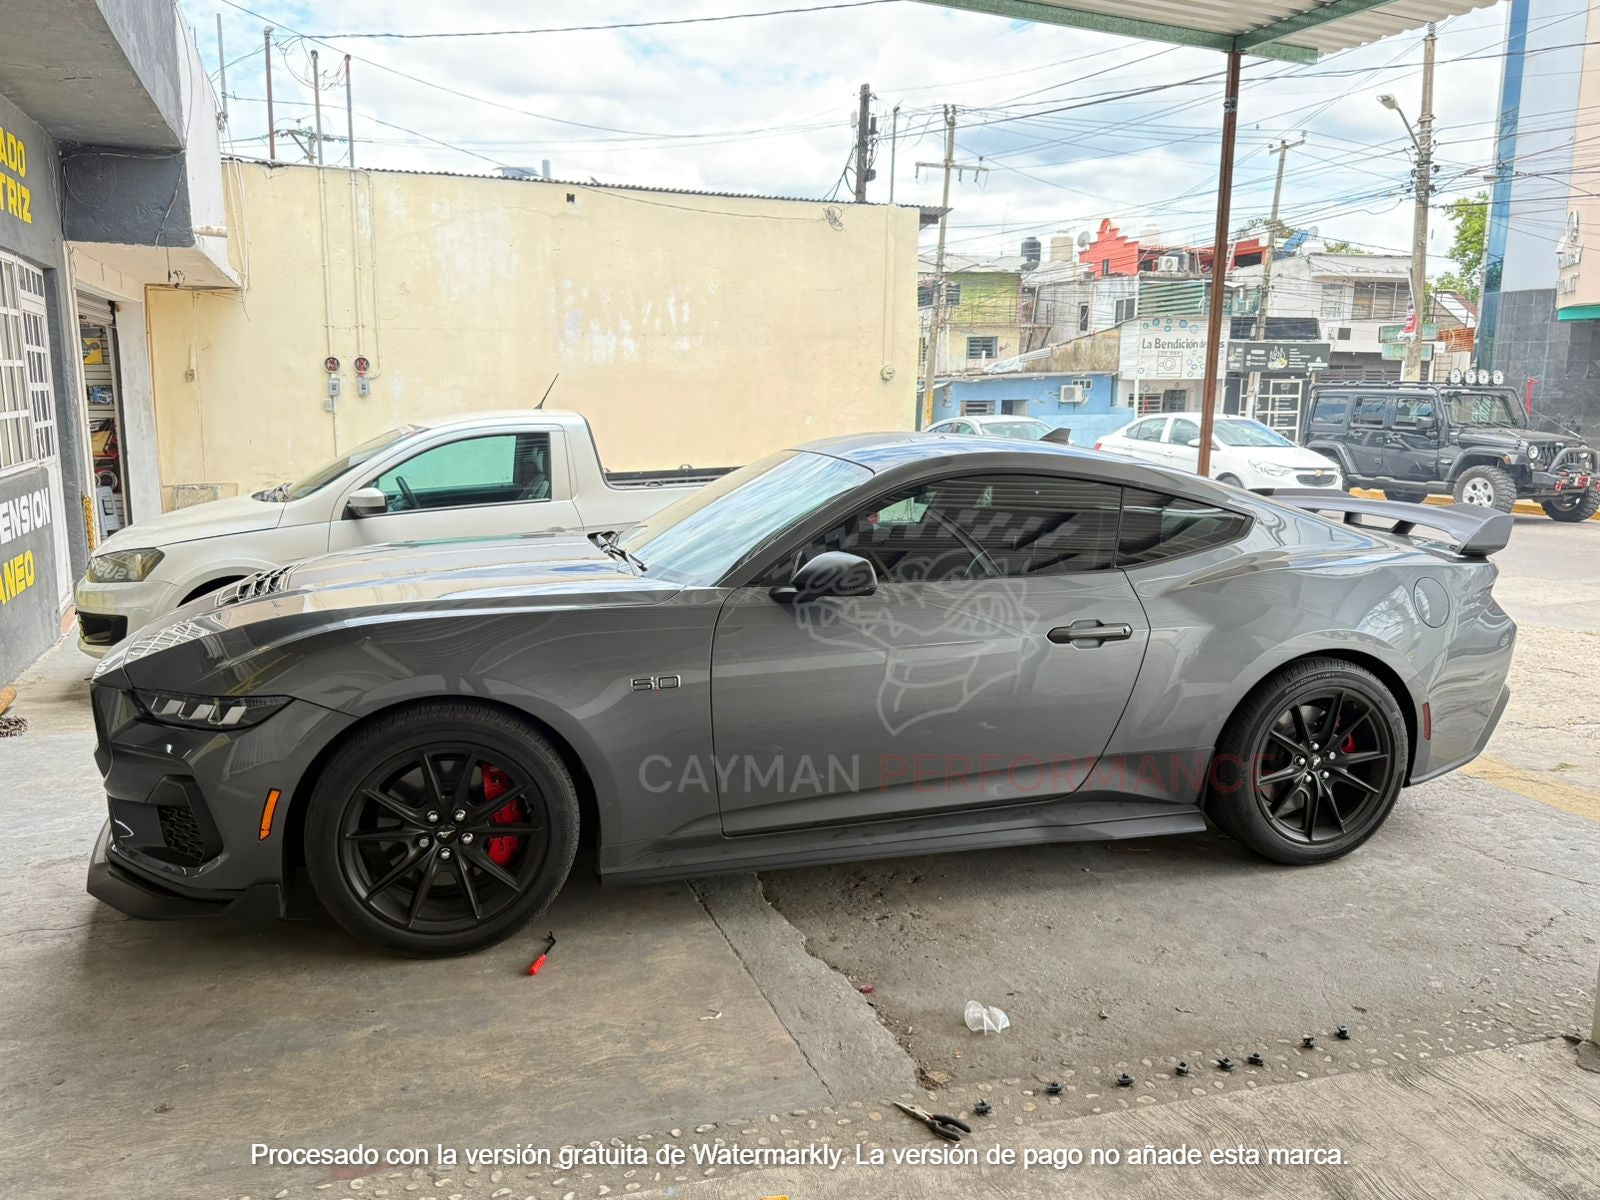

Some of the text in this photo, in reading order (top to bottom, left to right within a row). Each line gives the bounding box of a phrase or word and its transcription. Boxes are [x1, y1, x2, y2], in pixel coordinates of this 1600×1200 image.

[1142, 338, 1152, 349] La
[1155, 337, 1198, 349] Bendición
[0, 487, 51, 545] ENSION
